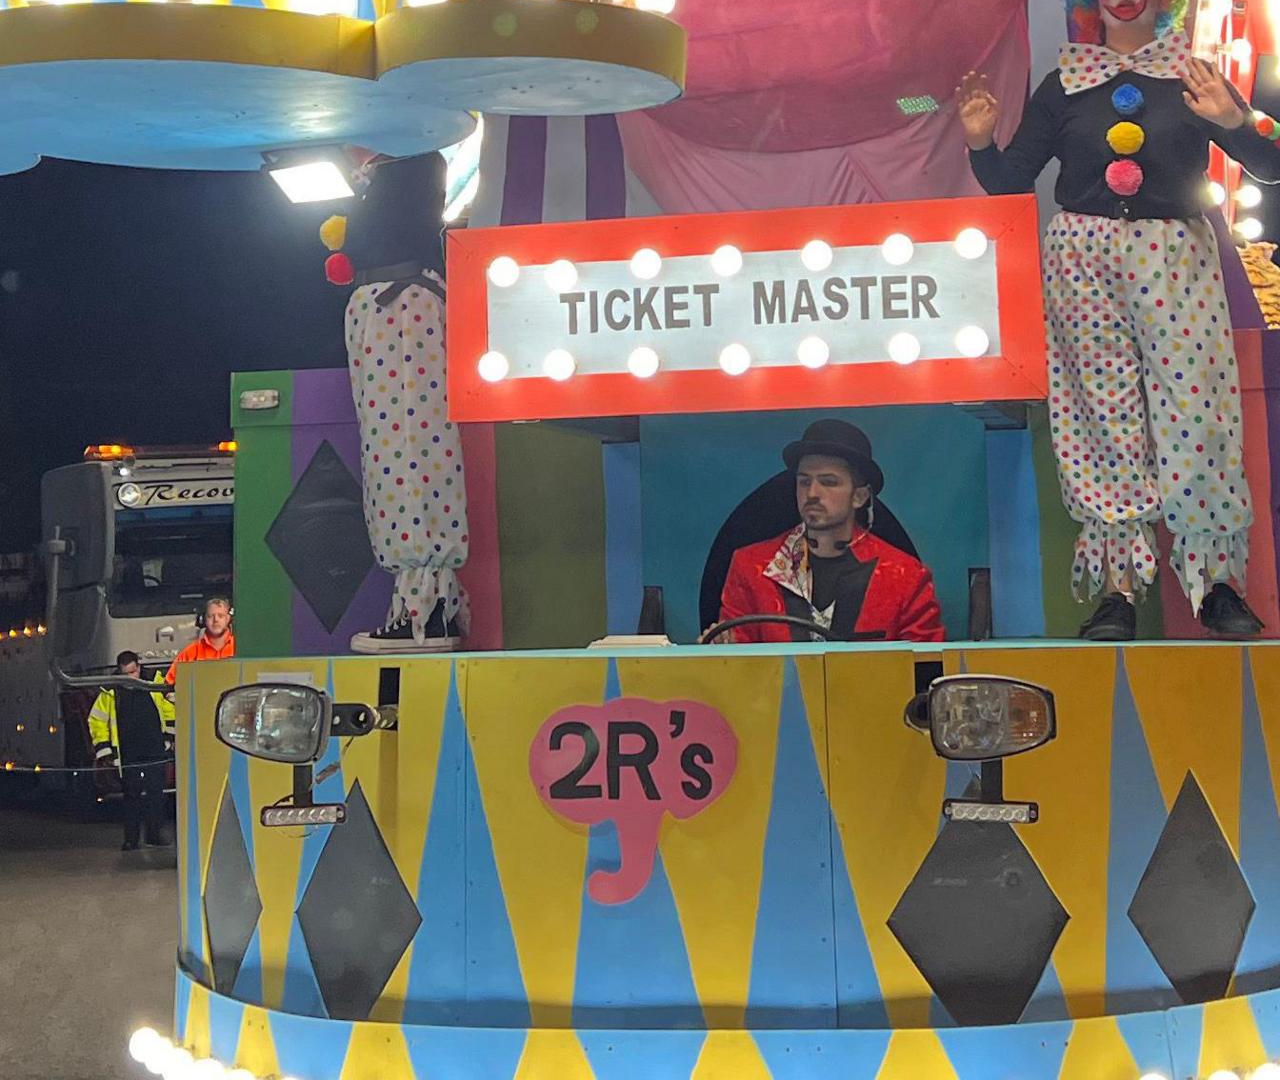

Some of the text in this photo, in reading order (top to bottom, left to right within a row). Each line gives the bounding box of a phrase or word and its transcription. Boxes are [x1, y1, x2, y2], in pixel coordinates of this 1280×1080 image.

[559, 275, 941, 335] TICKET MASTER
[548, 710, 714, 801] 2R's
